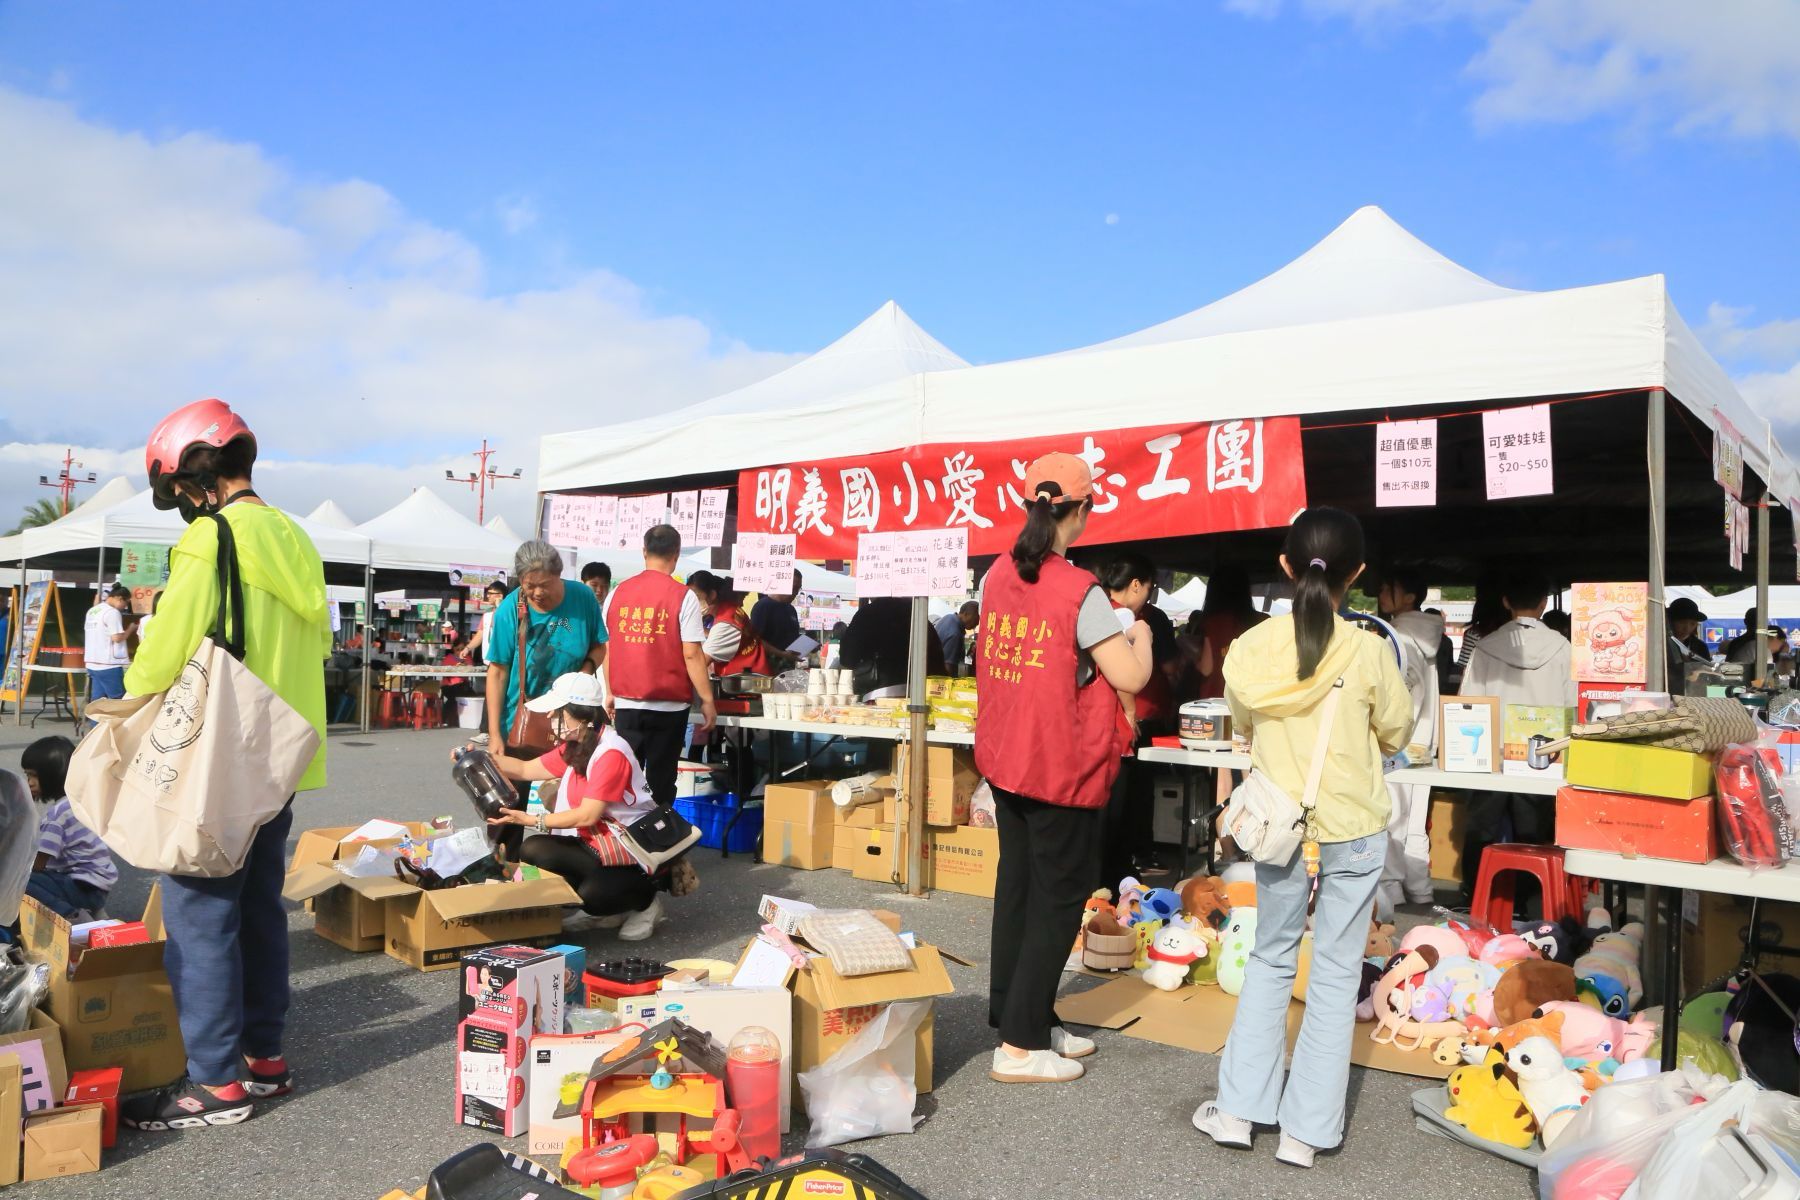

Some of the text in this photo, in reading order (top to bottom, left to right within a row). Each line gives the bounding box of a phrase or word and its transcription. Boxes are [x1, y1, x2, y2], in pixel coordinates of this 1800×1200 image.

[1380, 436, 1433, 452] 超值優惠
[1488, 430, 1547, 450] 可愛娃娃
[1381, 457, 1432, 469] 一個$10元
[1498, 458, 1548, 473] $20~$50
[1382, 480, 1430, 491] 售出不退換
[619, 606, 669, 621] 明義國小
[618, 619, 667, 635] 愛心志工
[987, 611, 1053, 643] 明義國小
[983, 634, 1045, 669] 愛心志工
[806, 1181, 843, 1191] Fisher-Price
